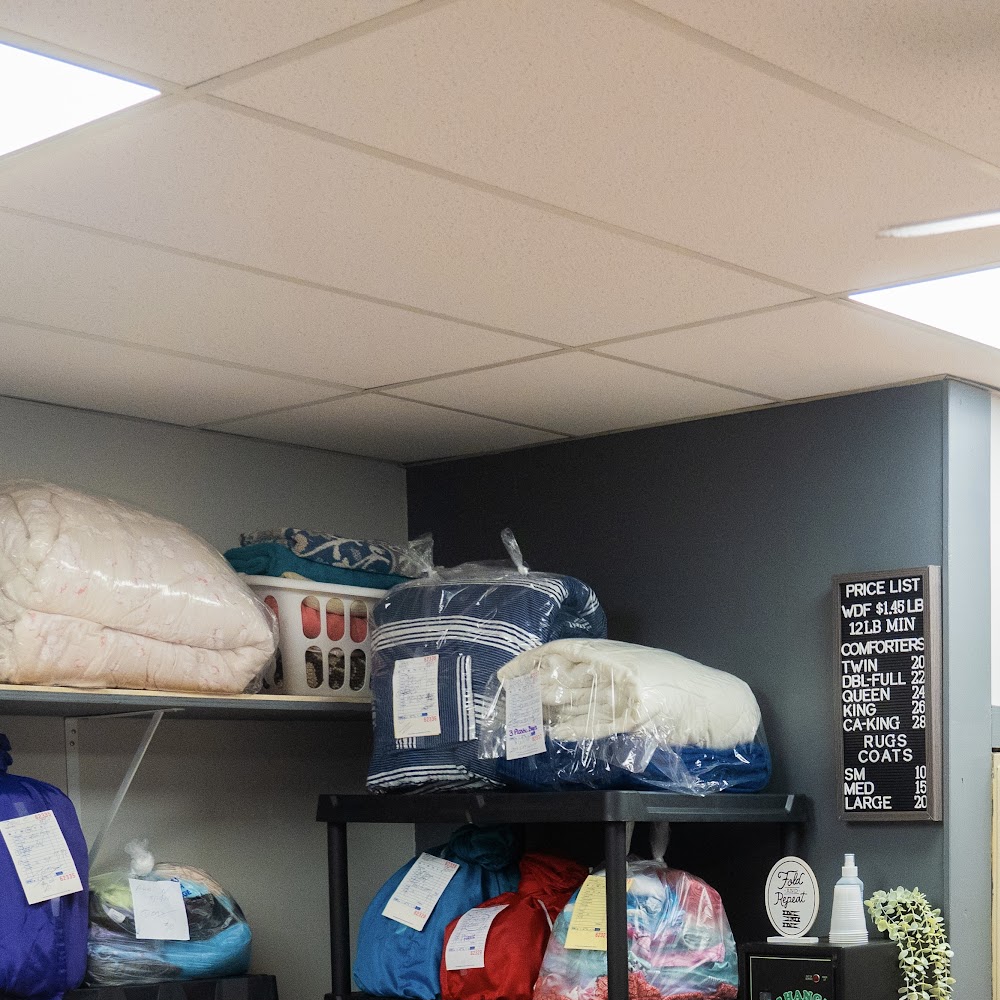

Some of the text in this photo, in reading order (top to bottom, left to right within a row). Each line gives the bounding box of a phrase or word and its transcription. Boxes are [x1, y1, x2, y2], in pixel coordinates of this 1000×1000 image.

[846, 578, 920, 598] PRICE LIST
[842, 598, 924, 618] WDF $1.45 LB
[886, 617, 916, 633] MIN
[841, 637, 924, 656] COMFORTERS
[842, 655, 925, 674] TWIN 20
[842, 670, 925, 688] DBL-FULL 22
[842, 686, 925, 703] QUEEN 24
[843, 700, 925, 717] KING 26
[843, 715, 926, 731] CA-KING 28
[864, 734, 907, 748] RUGS
[858, 748, 913, 763] COATS
[845, 765, 926, 781] SM 10
[844, 780, 927, 795] MED 15
[845, 795, 927, 810] LARGE 20
[778, 871, 805, 889] Fold
[774, 892, 807, 908] Repeat
